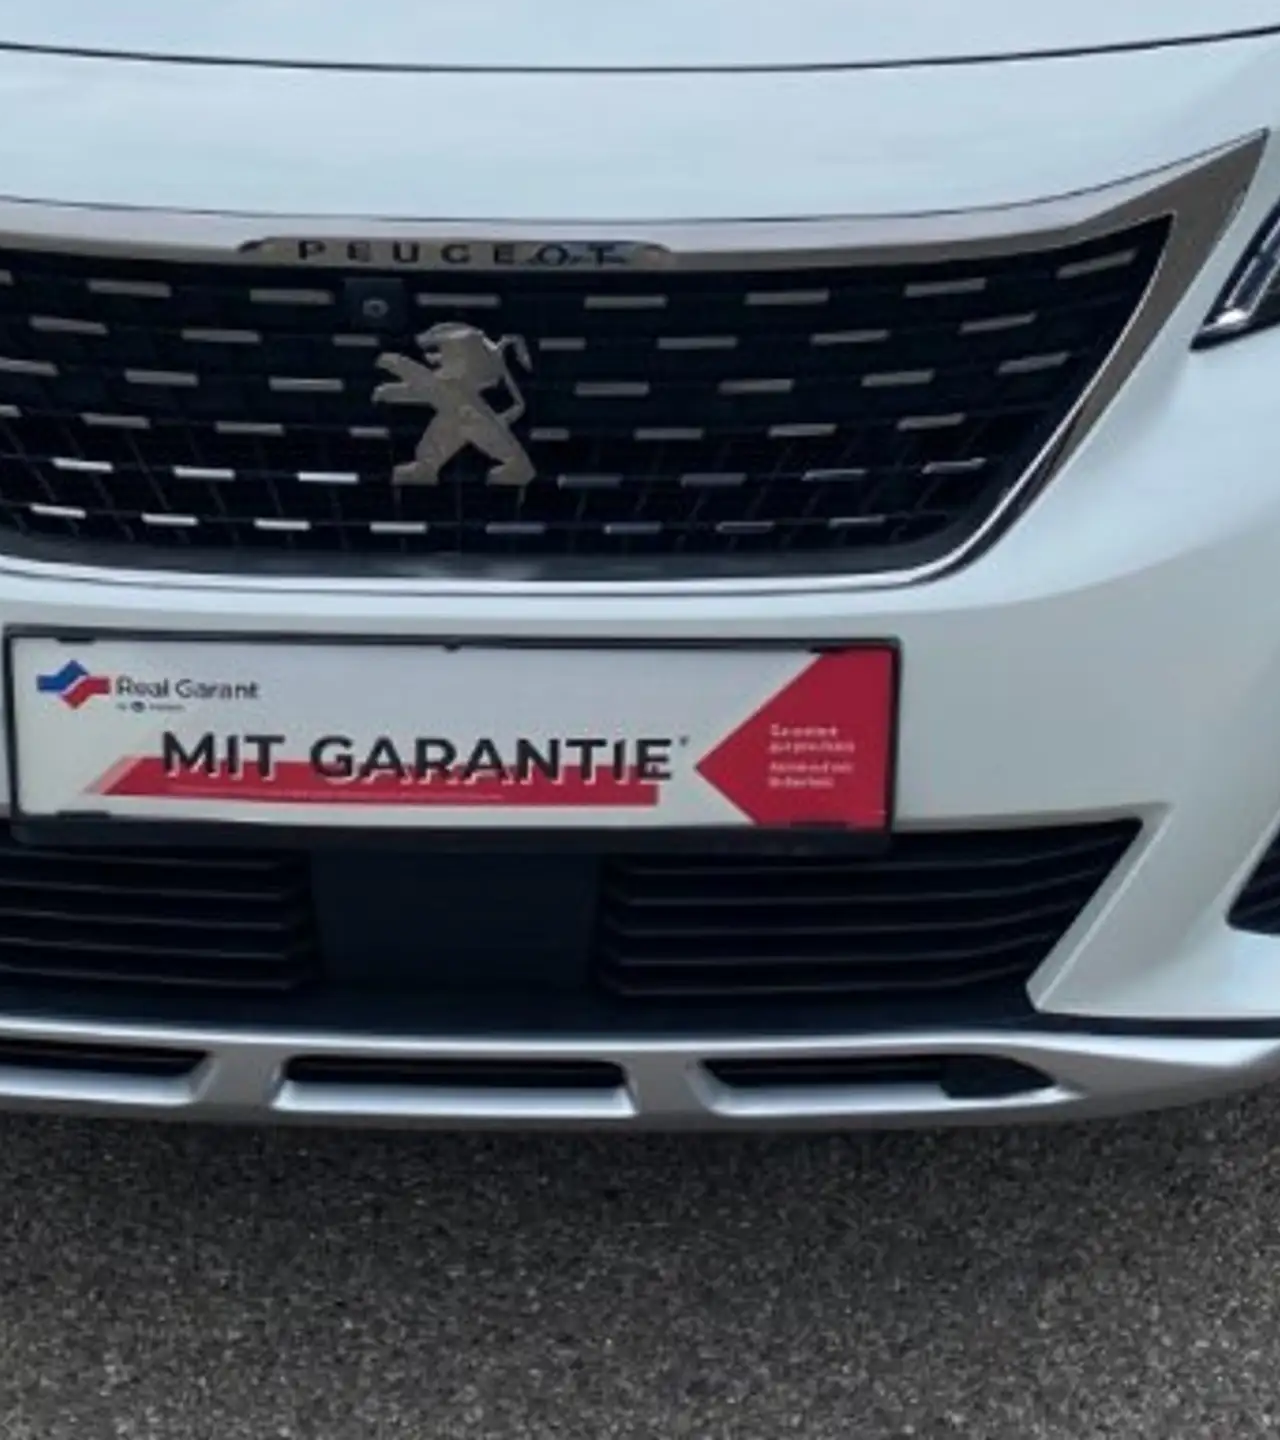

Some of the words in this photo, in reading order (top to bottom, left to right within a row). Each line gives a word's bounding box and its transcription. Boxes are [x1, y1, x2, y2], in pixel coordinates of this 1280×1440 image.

[297, 239, 618, 265] PEUGEOT
[116, 676, 168, 698] Real
[175, 678, 259, 699] Garant
[160, 730, 285, 780] MIT
